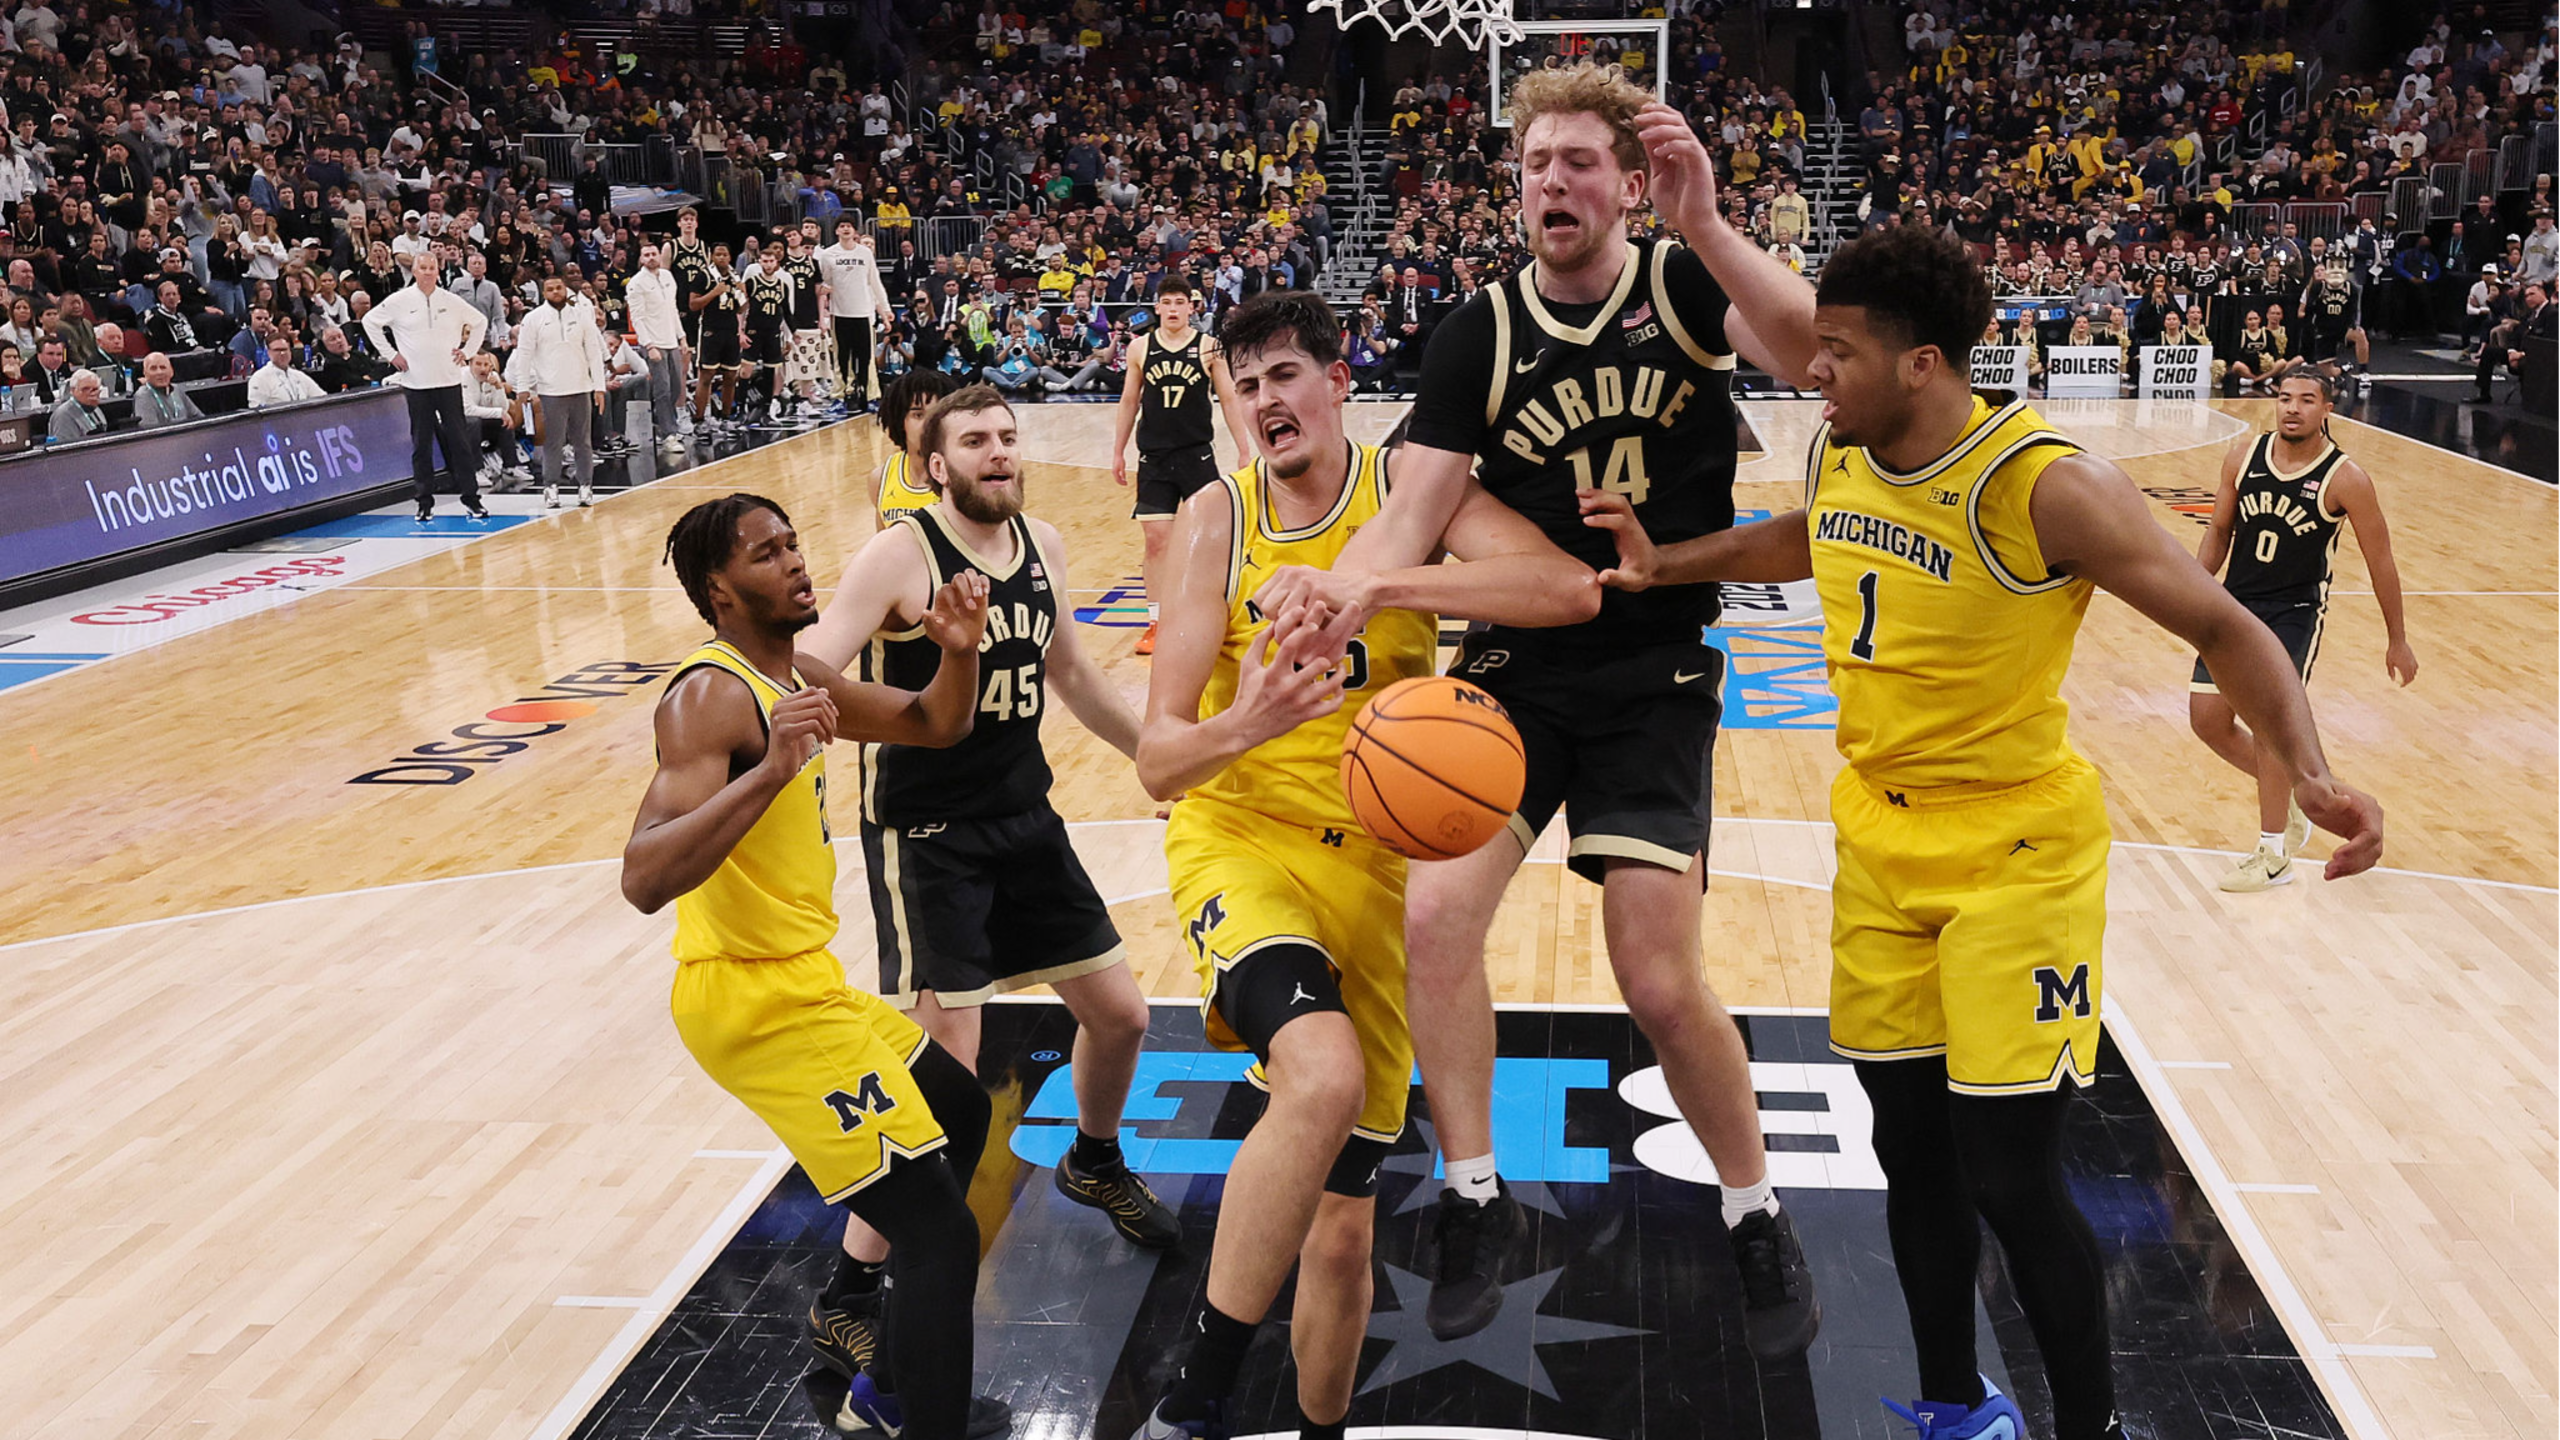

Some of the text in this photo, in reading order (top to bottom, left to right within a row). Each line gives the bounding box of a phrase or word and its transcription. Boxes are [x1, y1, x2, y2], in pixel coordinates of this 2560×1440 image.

[797, 277, 806, 289] 5
[762, 301, 776, 315] 41
[1145, 360, 1202, 386] PURDUE
[1971, 348, 2016, 365] CHOO
[1971, 368, 2015, 385] CHOO
[2051, 358, 2119, 375] BOILERS
[2153, 348, 2198, 365] CHOO
[2153, 367, 2198, 384] CHOO
[1161, 385, 1186, 409] 17
[1503, 365, 1697, 467] PURDUE
[84, 424, 365, 533] Industrial ai is IFS
[1564, 435, 1651, 506] 14
[2239, 490, 2319, 537] PURDUE
[1815, 511, 1955, 584] MICHIGAN
[2255, 529, 2279, 564] 0
[70, 554, 347, 626] Chicago
[1849, 569, 1880, 663] 1
[979, 662, 1040, 722] 45
[344, 658, 685, 786] DISCOVER
[1320, 827, 1345, 848] M
[2032, 961, 2092, 1024] M
[824, 1070, 897, 1134] M
